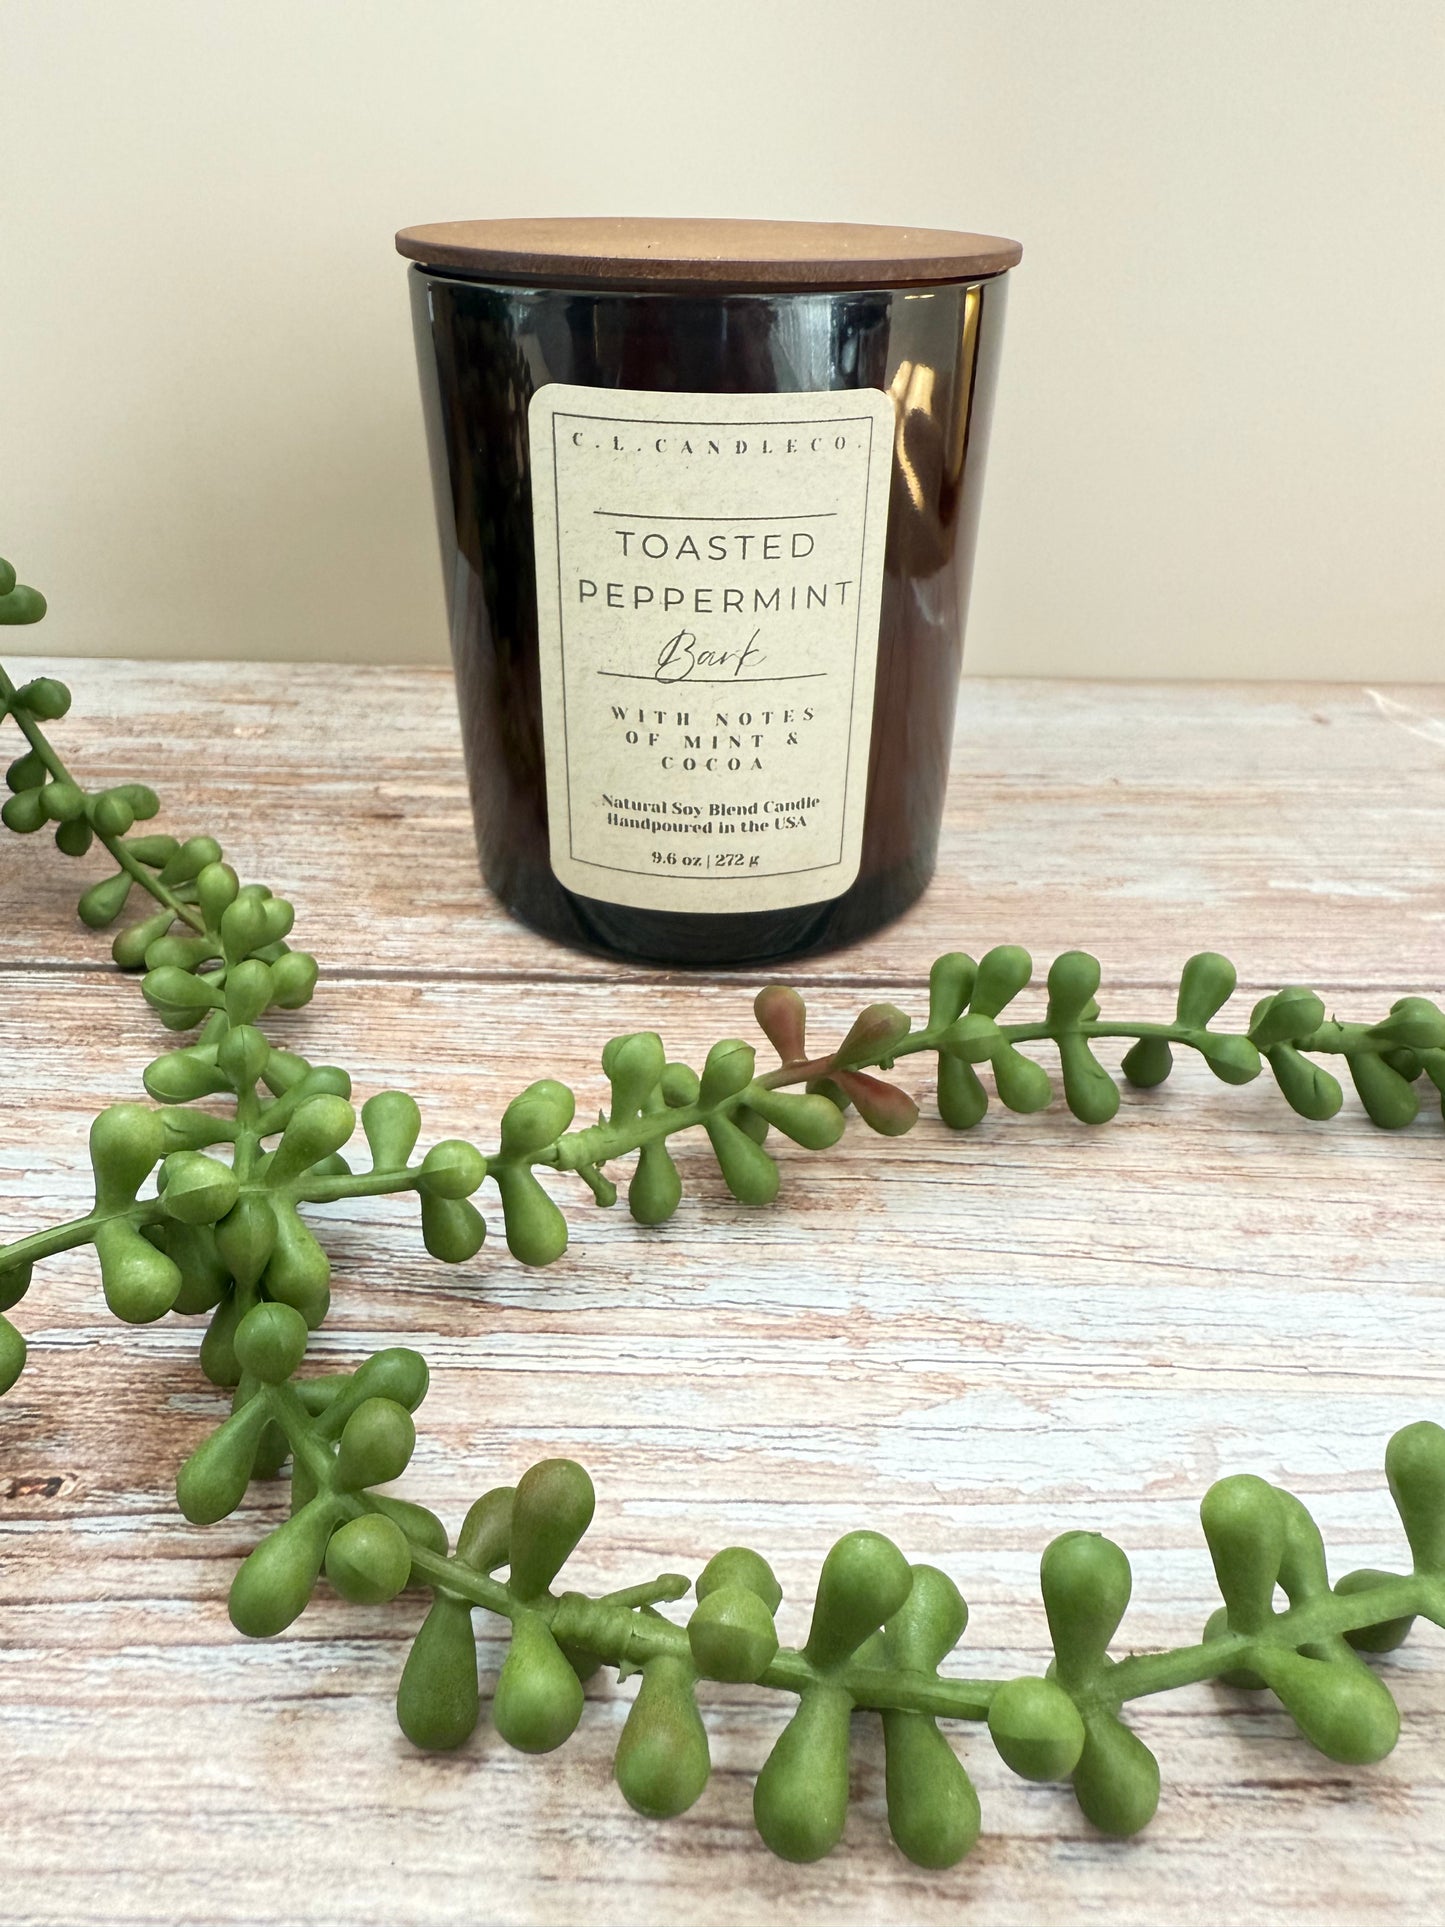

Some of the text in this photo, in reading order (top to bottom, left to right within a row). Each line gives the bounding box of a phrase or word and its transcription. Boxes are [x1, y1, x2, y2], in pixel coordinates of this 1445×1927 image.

[614, 530, 816, 561] TOASTED
[578, 578, 854, 614] PEPPERMINT
[654, 628, 768, 684] Bark
[610, 705, 816, 727] WITH NOTES
[625, 730, 799, 750] OF MINT &
[660, 755, 764, 772] COCOA
[601, 793, 821, 819] Natural Soy Blend Candle
[606, 811, 808, 835] Handpoured in the USA
[651, 851, 677, 866] 9.6
[681, 854, 702, 867] oz
[714, 852, 745, 867] 272
[749, 854, 760, 868] g
